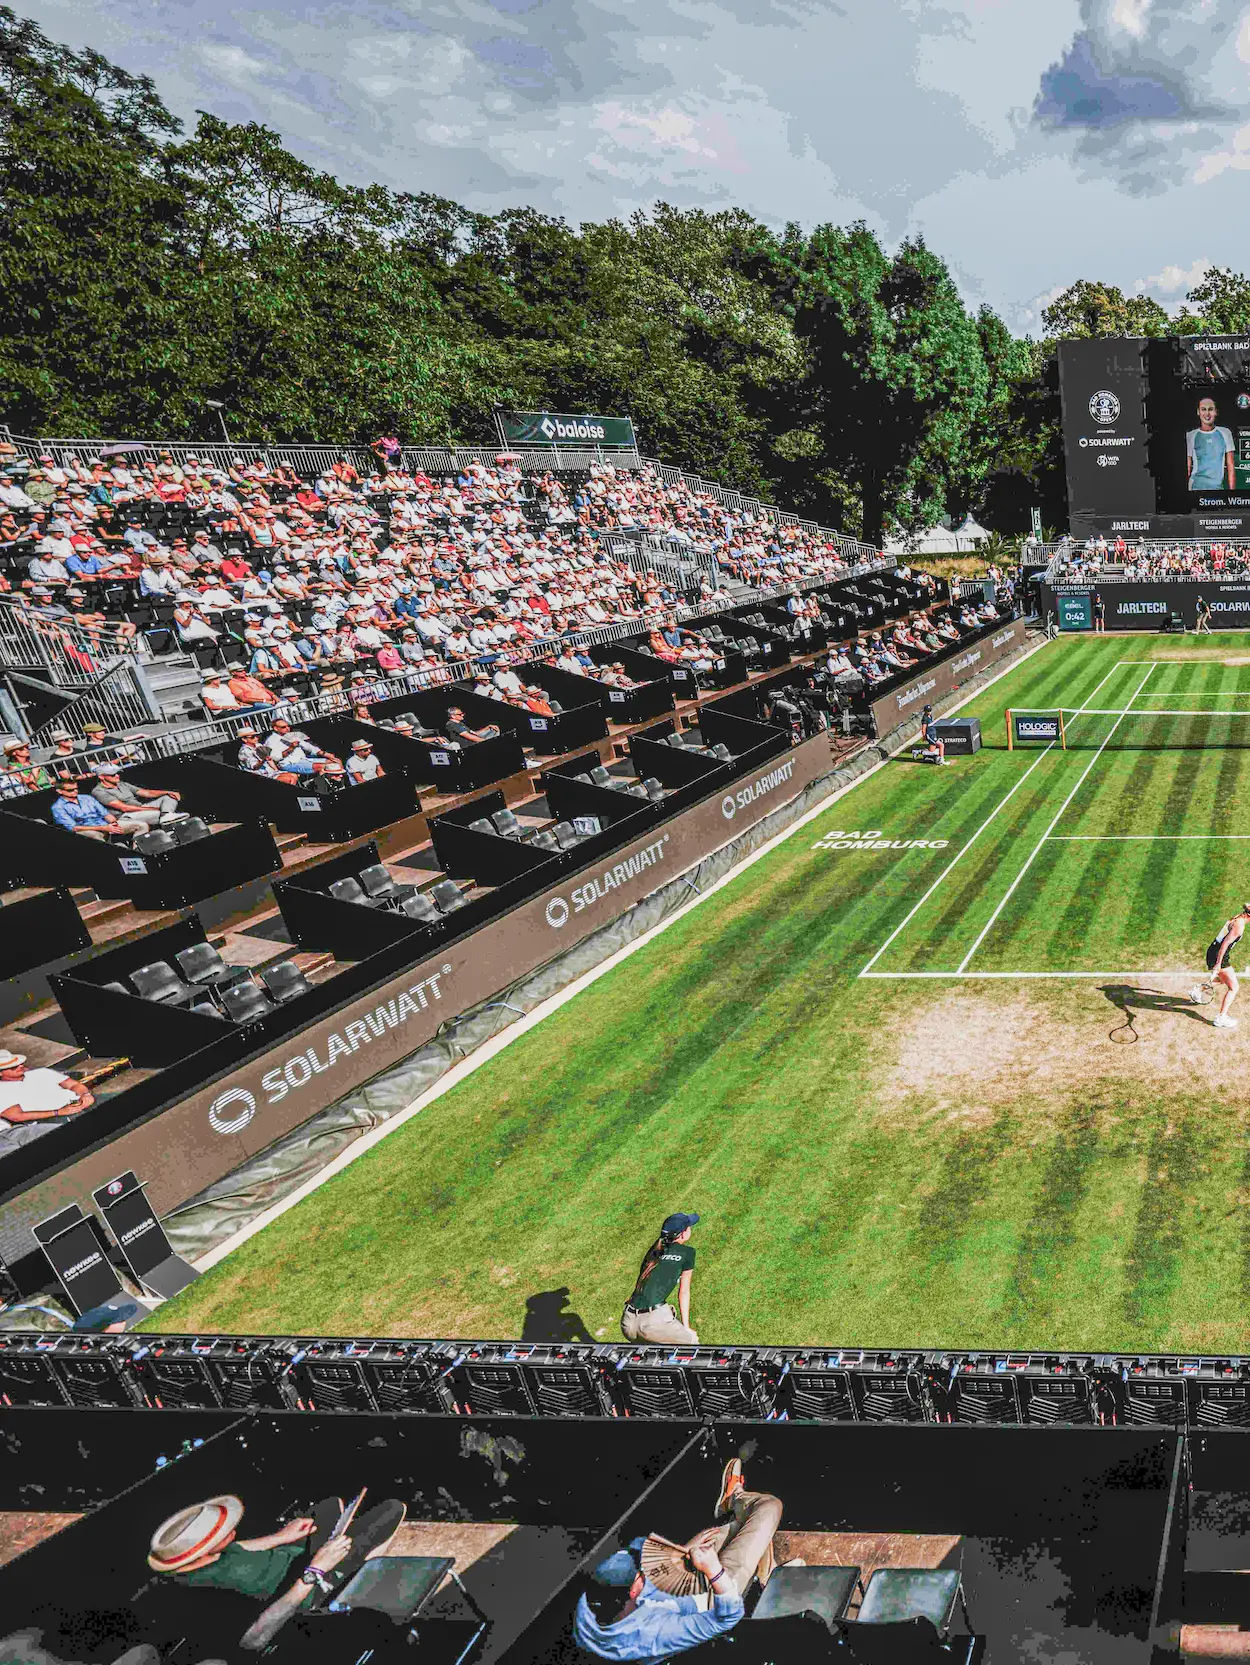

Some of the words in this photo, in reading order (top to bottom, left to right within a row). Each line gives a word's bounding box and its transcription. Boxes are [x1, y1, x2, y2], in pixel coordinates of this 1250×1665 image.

[1194, 343, 1232, 351] SPIELBANK
[1234, 342, 1250, 350] BAD
[555, 419, 605, 439] baloise
[1089, 438, 1133, 447] SOLARWATT
[1199, 498, 1226, 506] Strom.
[1111, 521, 1149, 530] JARLTECH
[1117, 602, 1167, 614] JARLTECH
[1065, 612, 1085, 621] 0:42
[1018, 722, 1057, 731] HOLOGIC
[823, 830, 883, 840] BAD
[811, 840, 950, 850] HOMBURG
